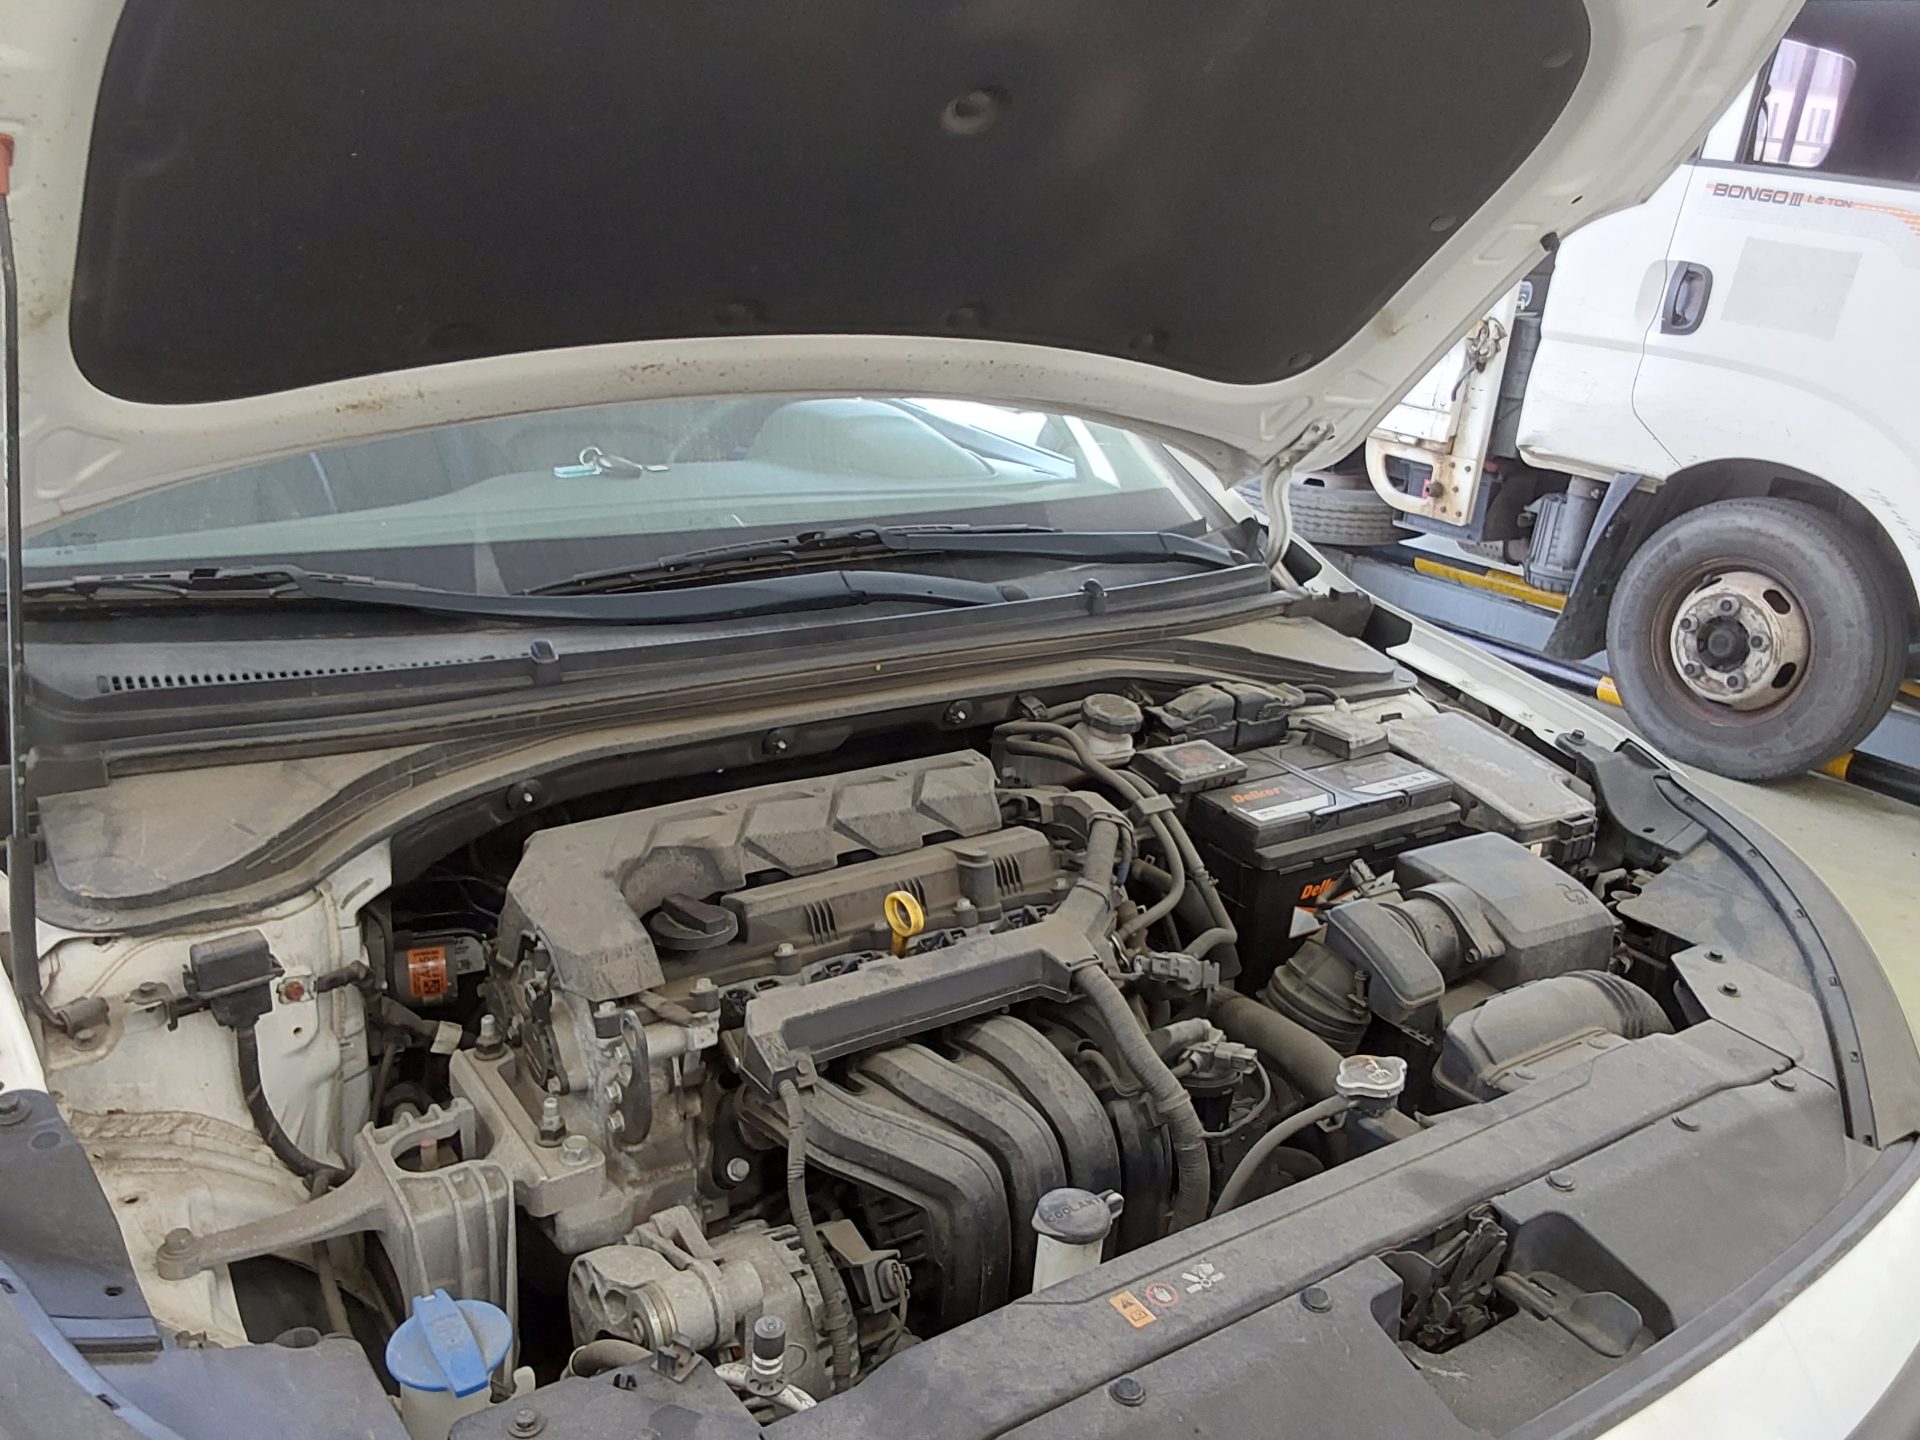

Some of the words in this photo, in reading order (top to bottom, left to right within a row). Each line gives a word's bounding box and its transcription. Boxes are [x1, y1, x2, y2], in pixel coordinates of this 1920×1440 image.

[1713, 182, 1789, 205] BONGO
[1827, 198, 1853, 209] TON
[1046, 1197, 1103, 1223] COOLANT
